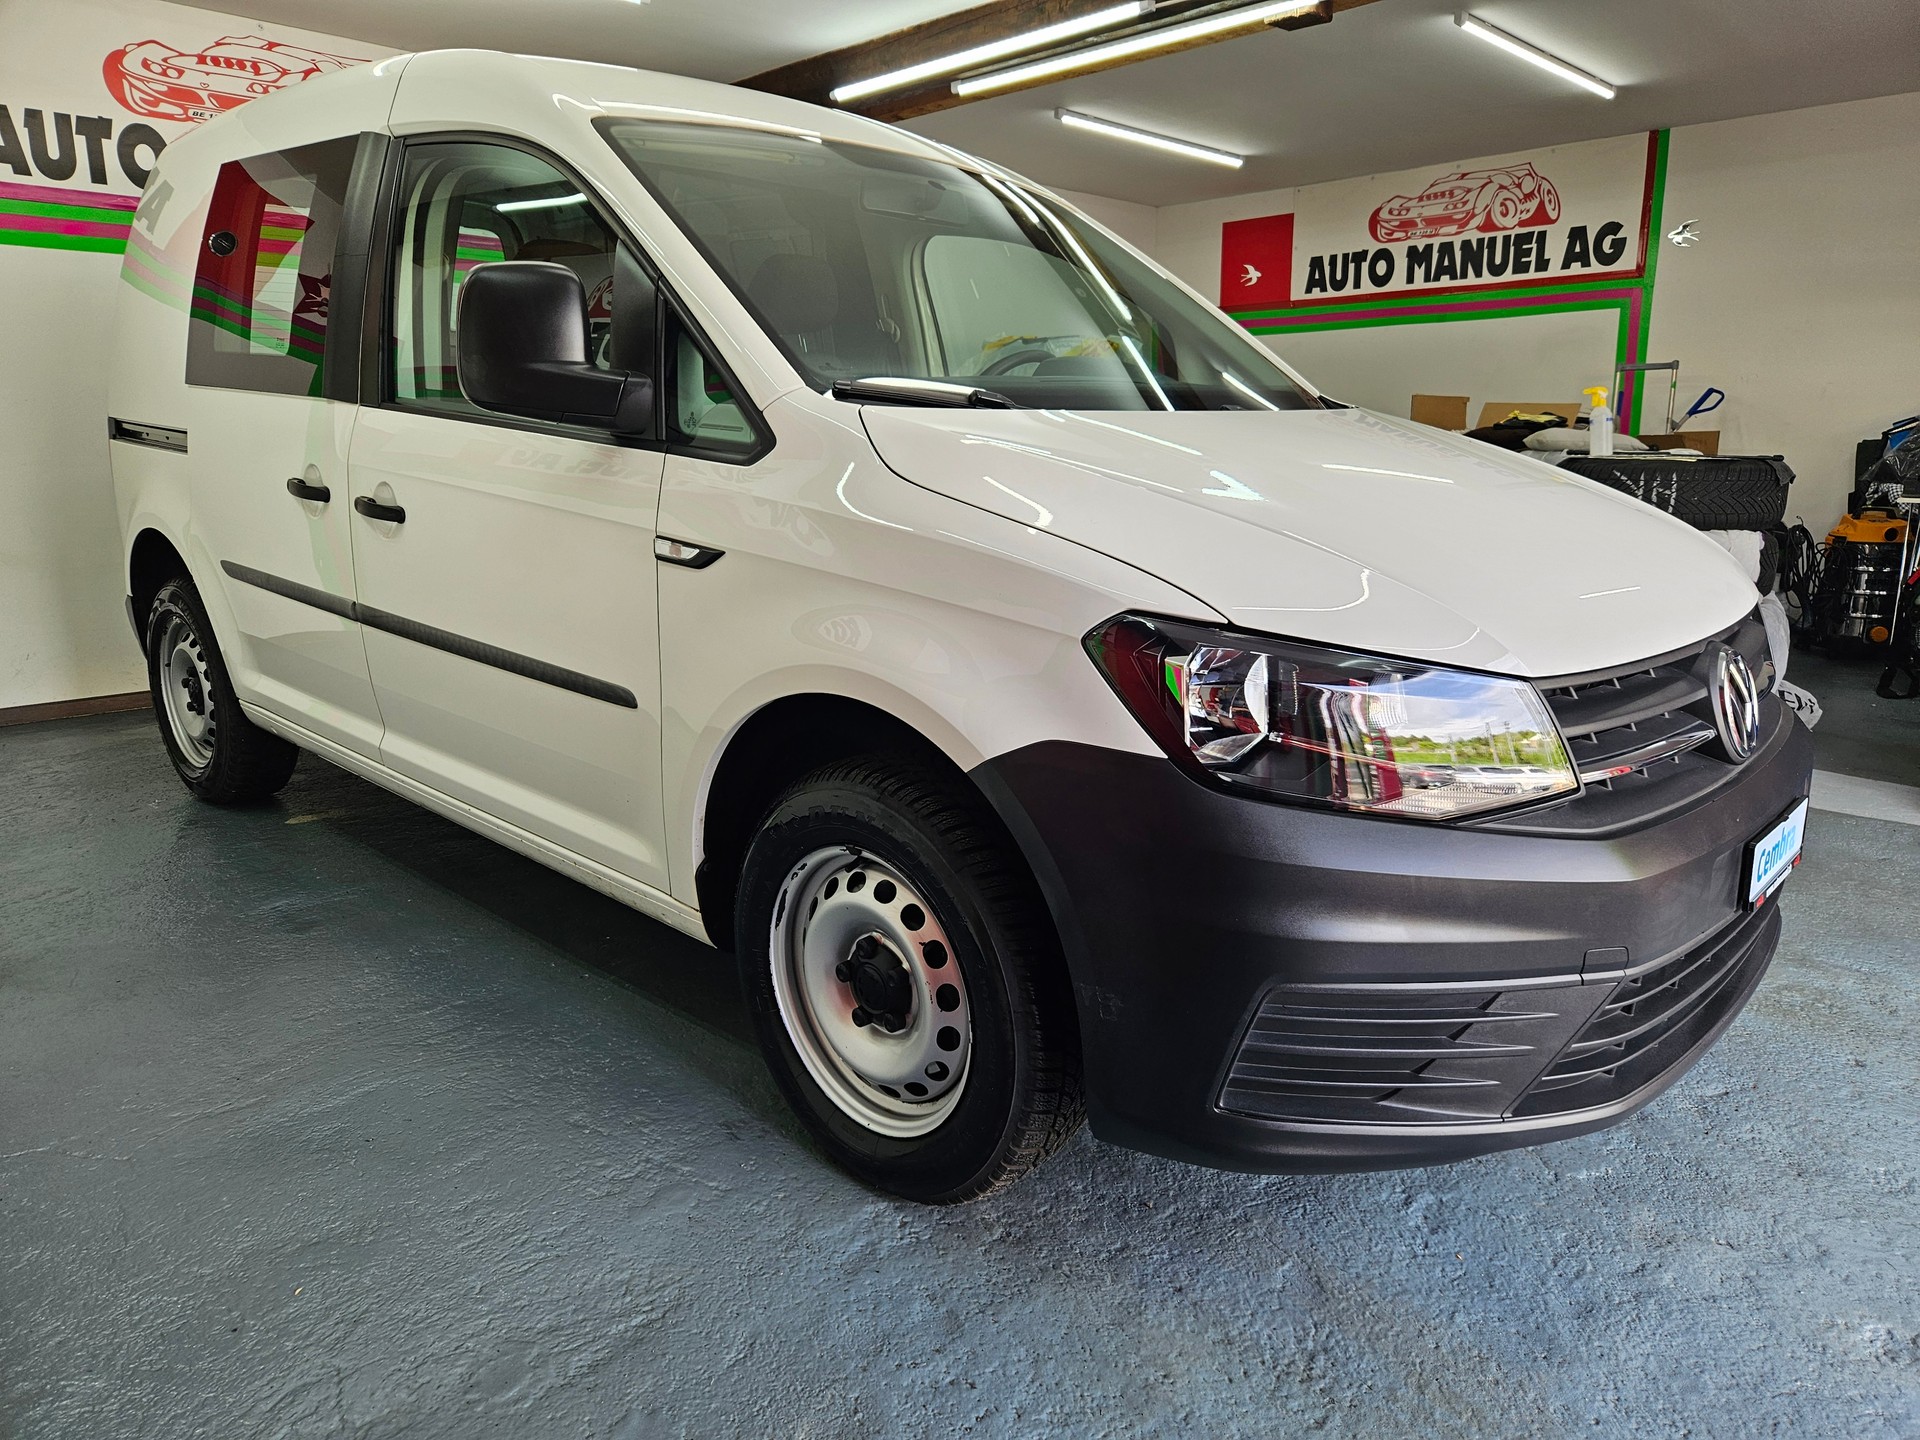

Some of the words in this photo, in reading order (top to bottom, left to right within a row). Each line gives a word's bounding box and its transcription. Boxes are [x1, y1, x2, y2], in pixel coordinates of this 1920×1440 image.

[1304, 247, 1396, 295] AUTO
[1405, 229, 1552, 285] MANUEL
[1560, 220, 1628, 271] AG
[1756, 824, 1797, 883] Cembra
